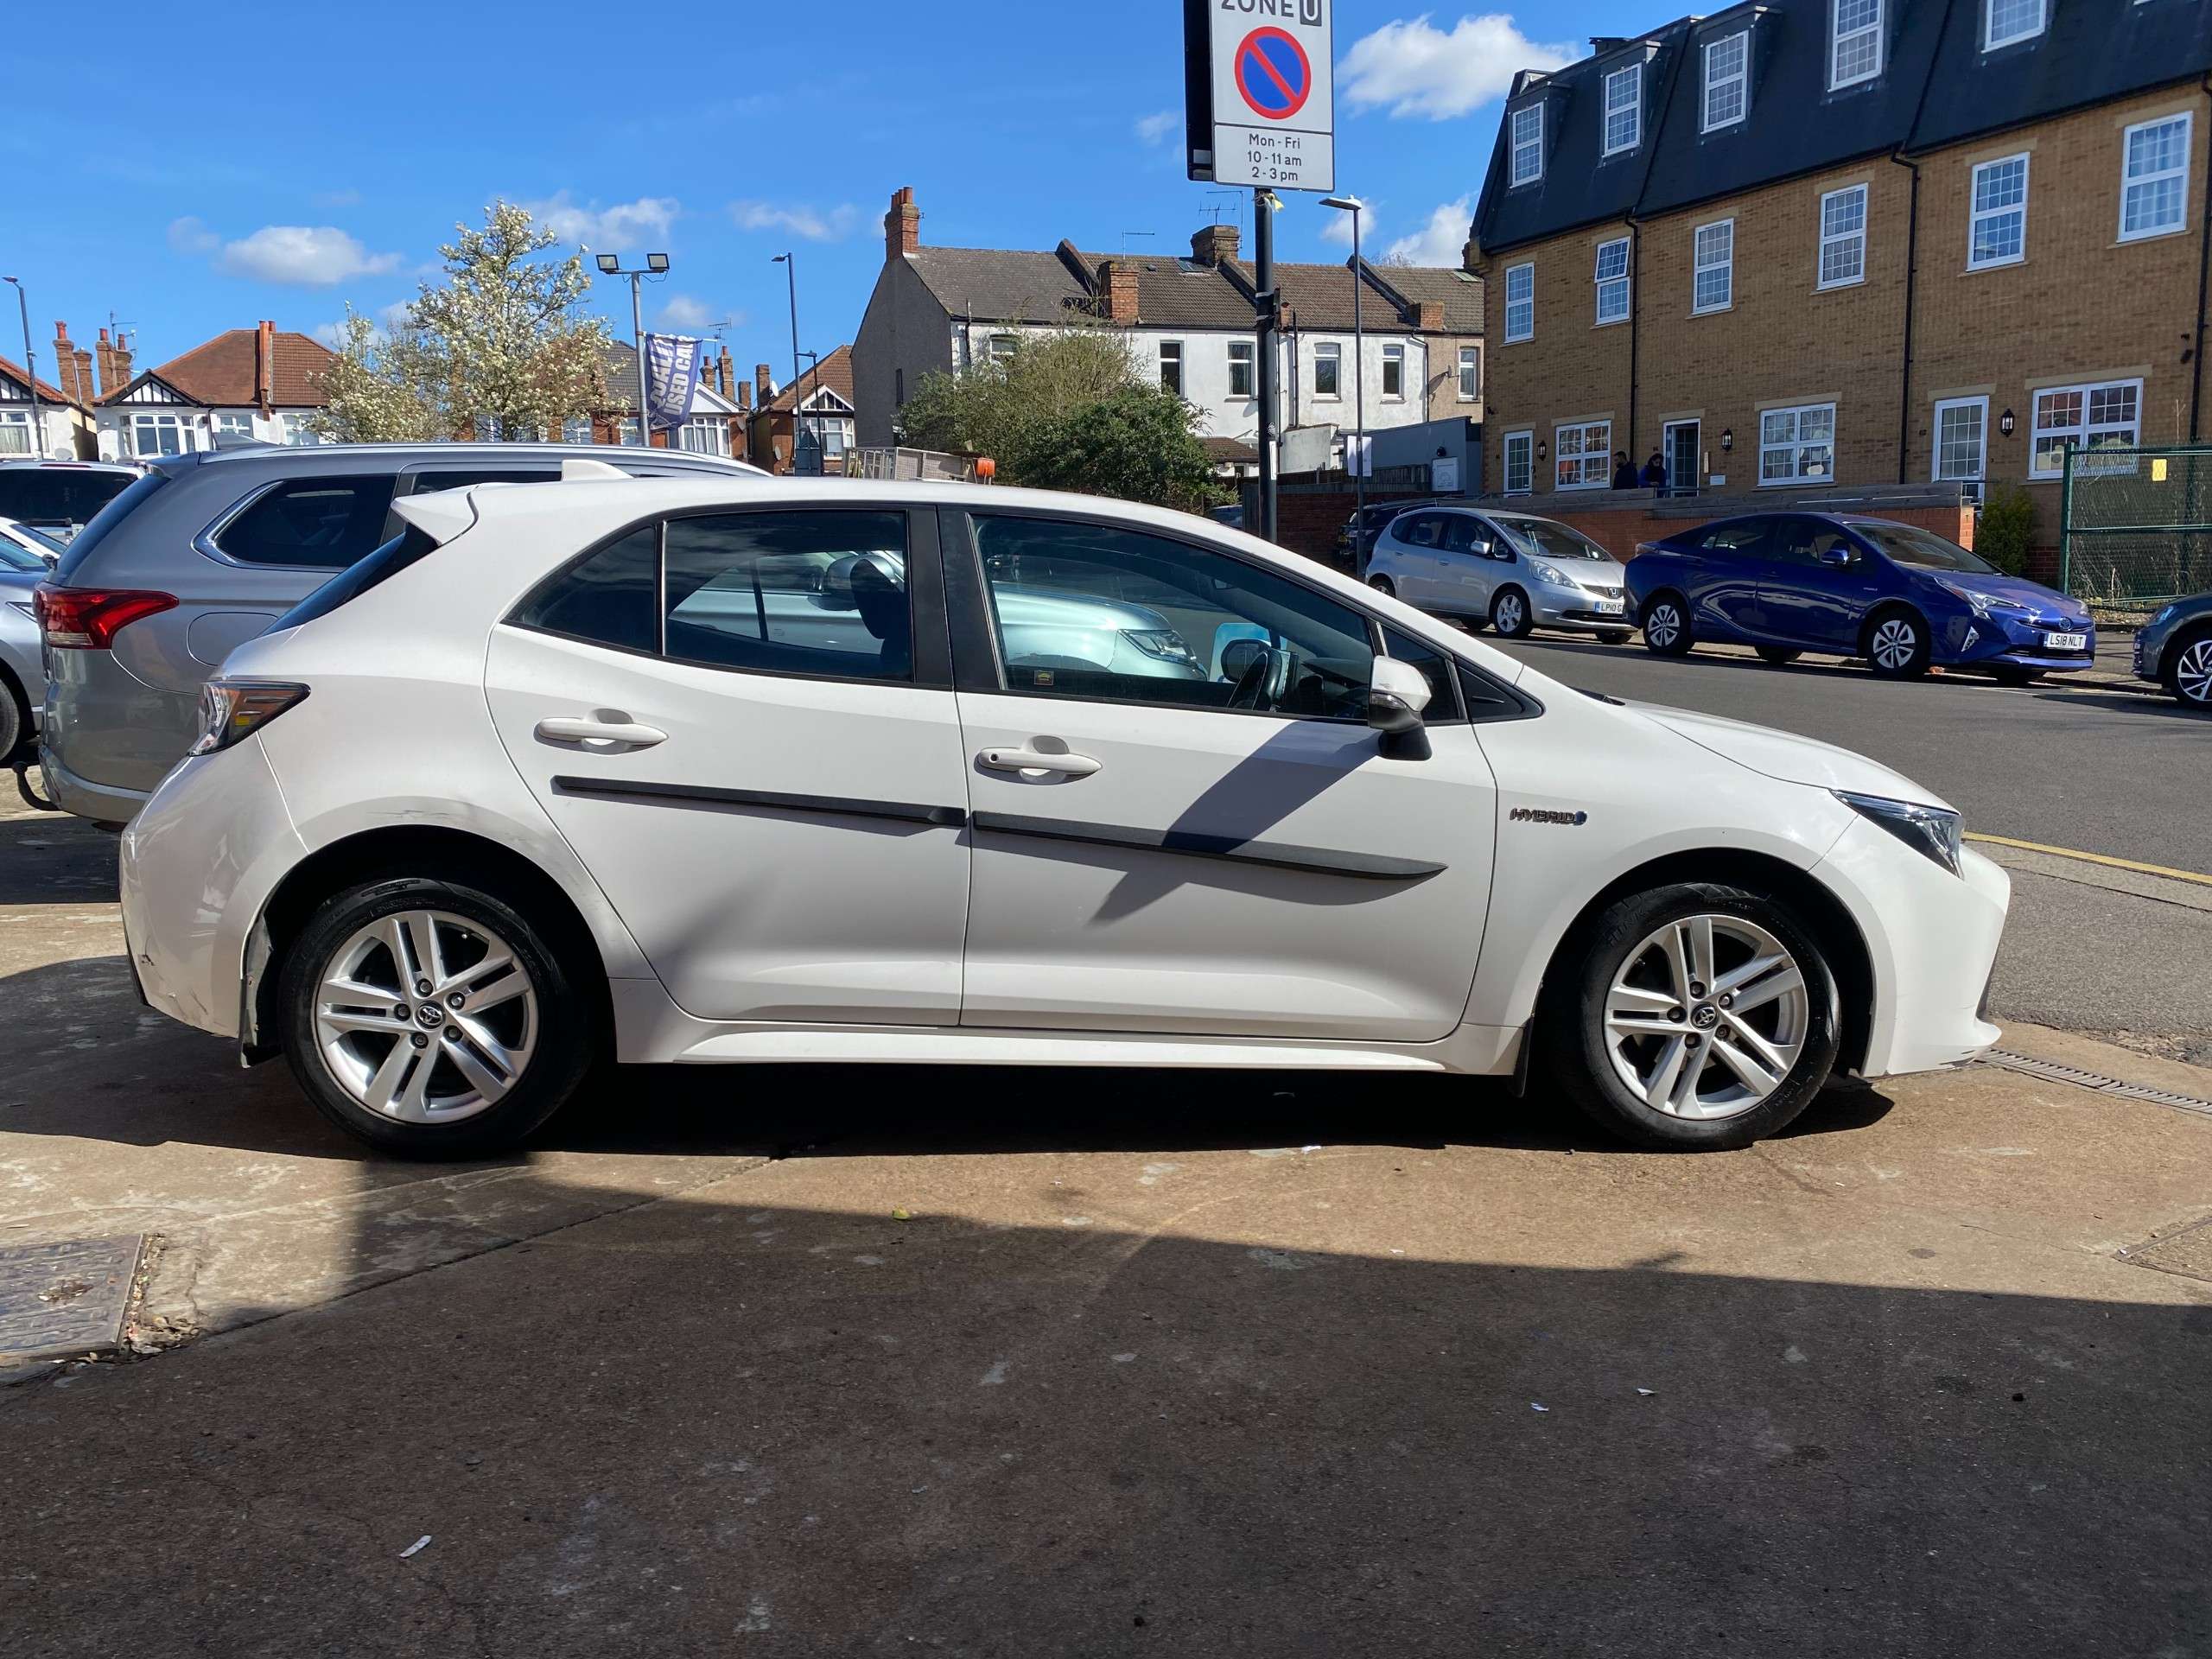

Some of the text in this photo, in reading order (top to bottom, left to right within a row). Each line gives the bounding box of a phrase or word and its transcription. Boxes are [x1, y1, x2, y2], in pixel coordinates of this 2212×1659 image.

[1249, 133, 1274, 147] Mon
[1285, 137, 1300, 149] Fri
[1248, 150, 1262, 162] 10
[1271, 152, 1281, 164] 11
[1284, 156, 1302, 167] am
[1251, 166, 1260, 178] 2
[1269, 168, 1277, 180] 3
[1280, 172, 1299, 182] pm
[664, 372, 690, 416] USED
[2050, 635, 2083, 647] LS18 NLT
[1509, 807, 1576, 825] HYBRID
